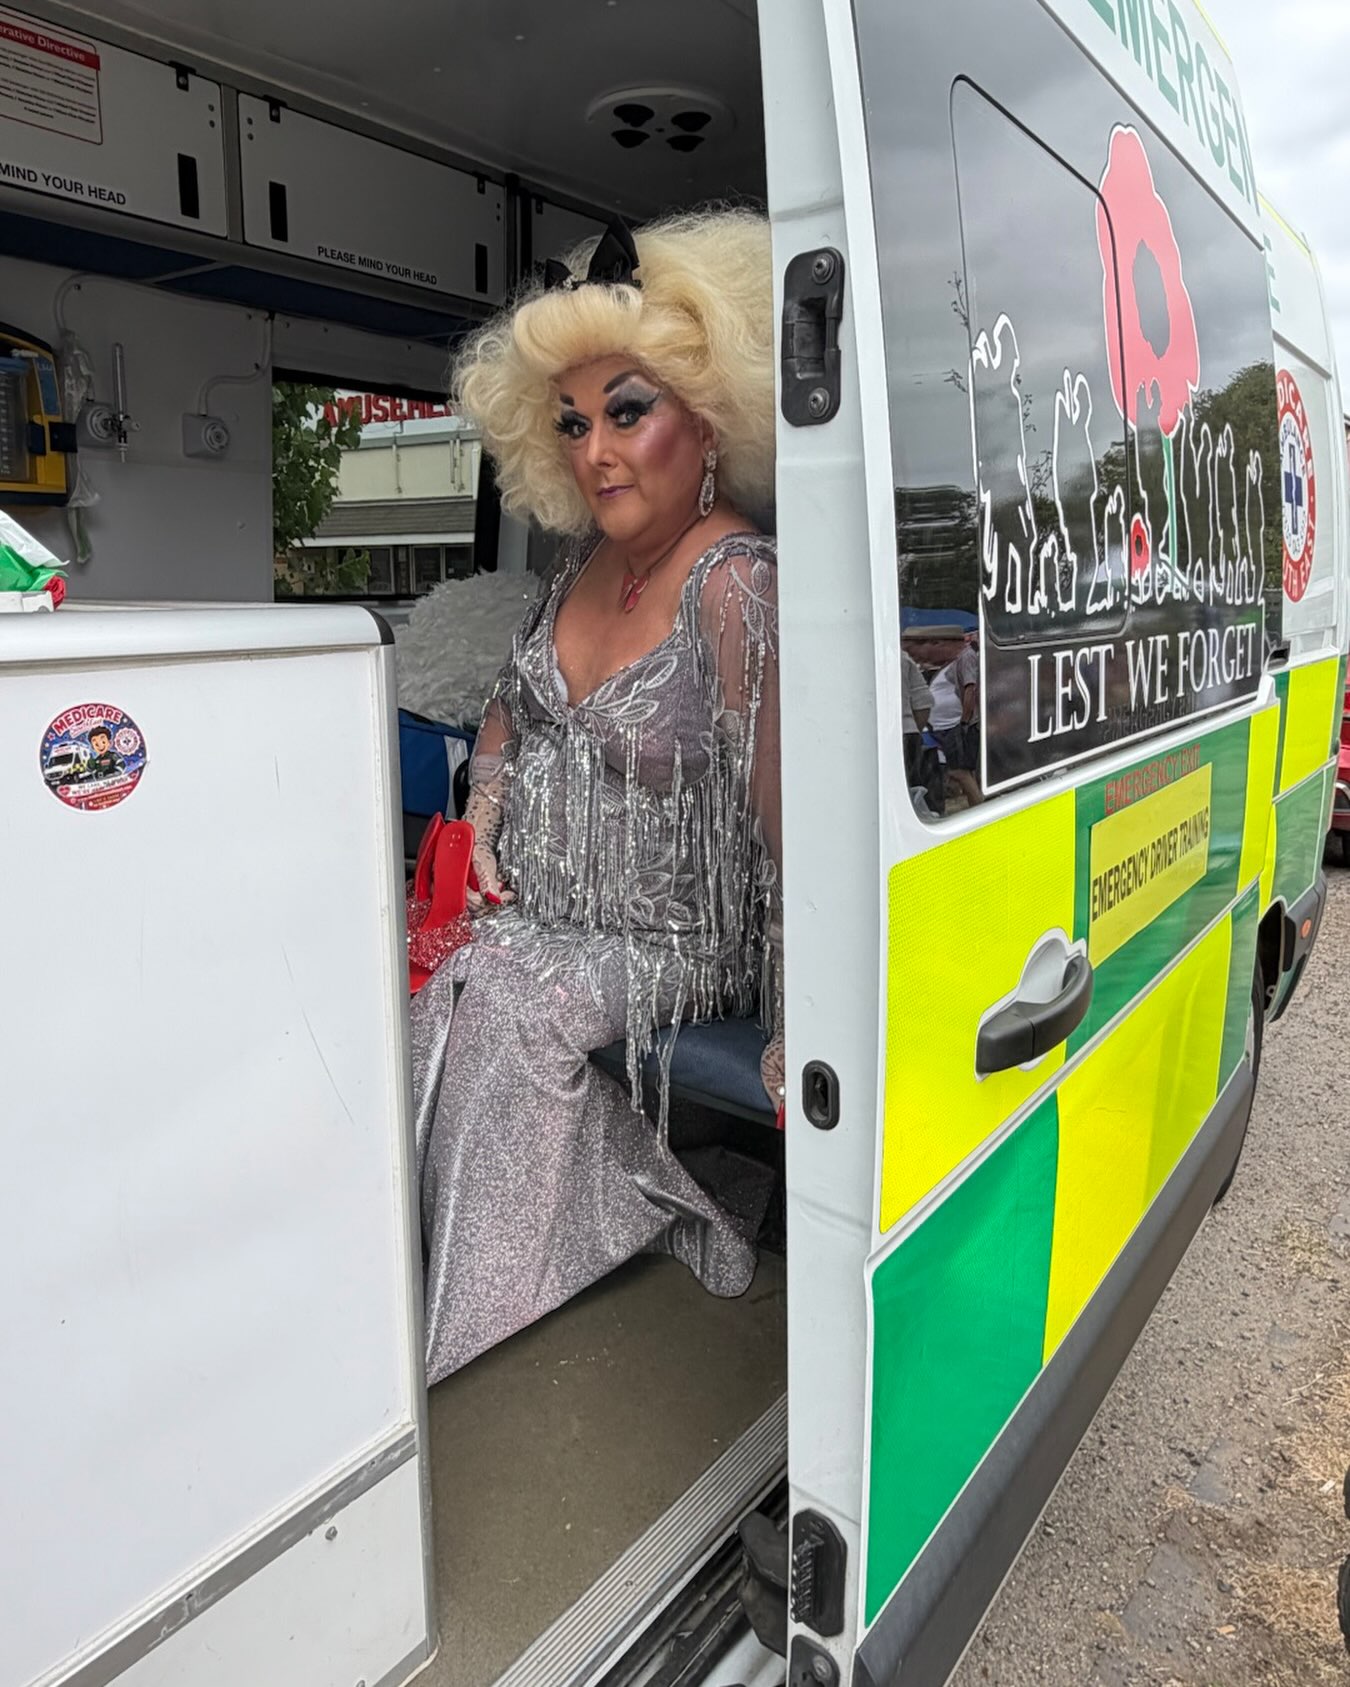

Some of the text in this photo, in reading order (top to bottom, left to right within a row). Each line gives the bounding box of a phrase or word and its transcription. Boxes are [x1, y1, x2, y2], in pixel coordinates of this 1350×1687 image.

[37, 34, 86, 61] Directive
[1088, 0, 1261, 217] MERGEN
[0, 162, 126, 205] MIND YOUR HEAD
[317, 245, 437, 285] PLEASE MIND YOUR HEAD
[1027, 622, 1257, 743] LEST WE FORGET
[53, 706, 122, 735] MEDICARE
[1105, 743, 1200, 816] EMERGENCY EXIT
[1091, 806, 1209, 922] EMERGENCY DRIVER TRAINING
